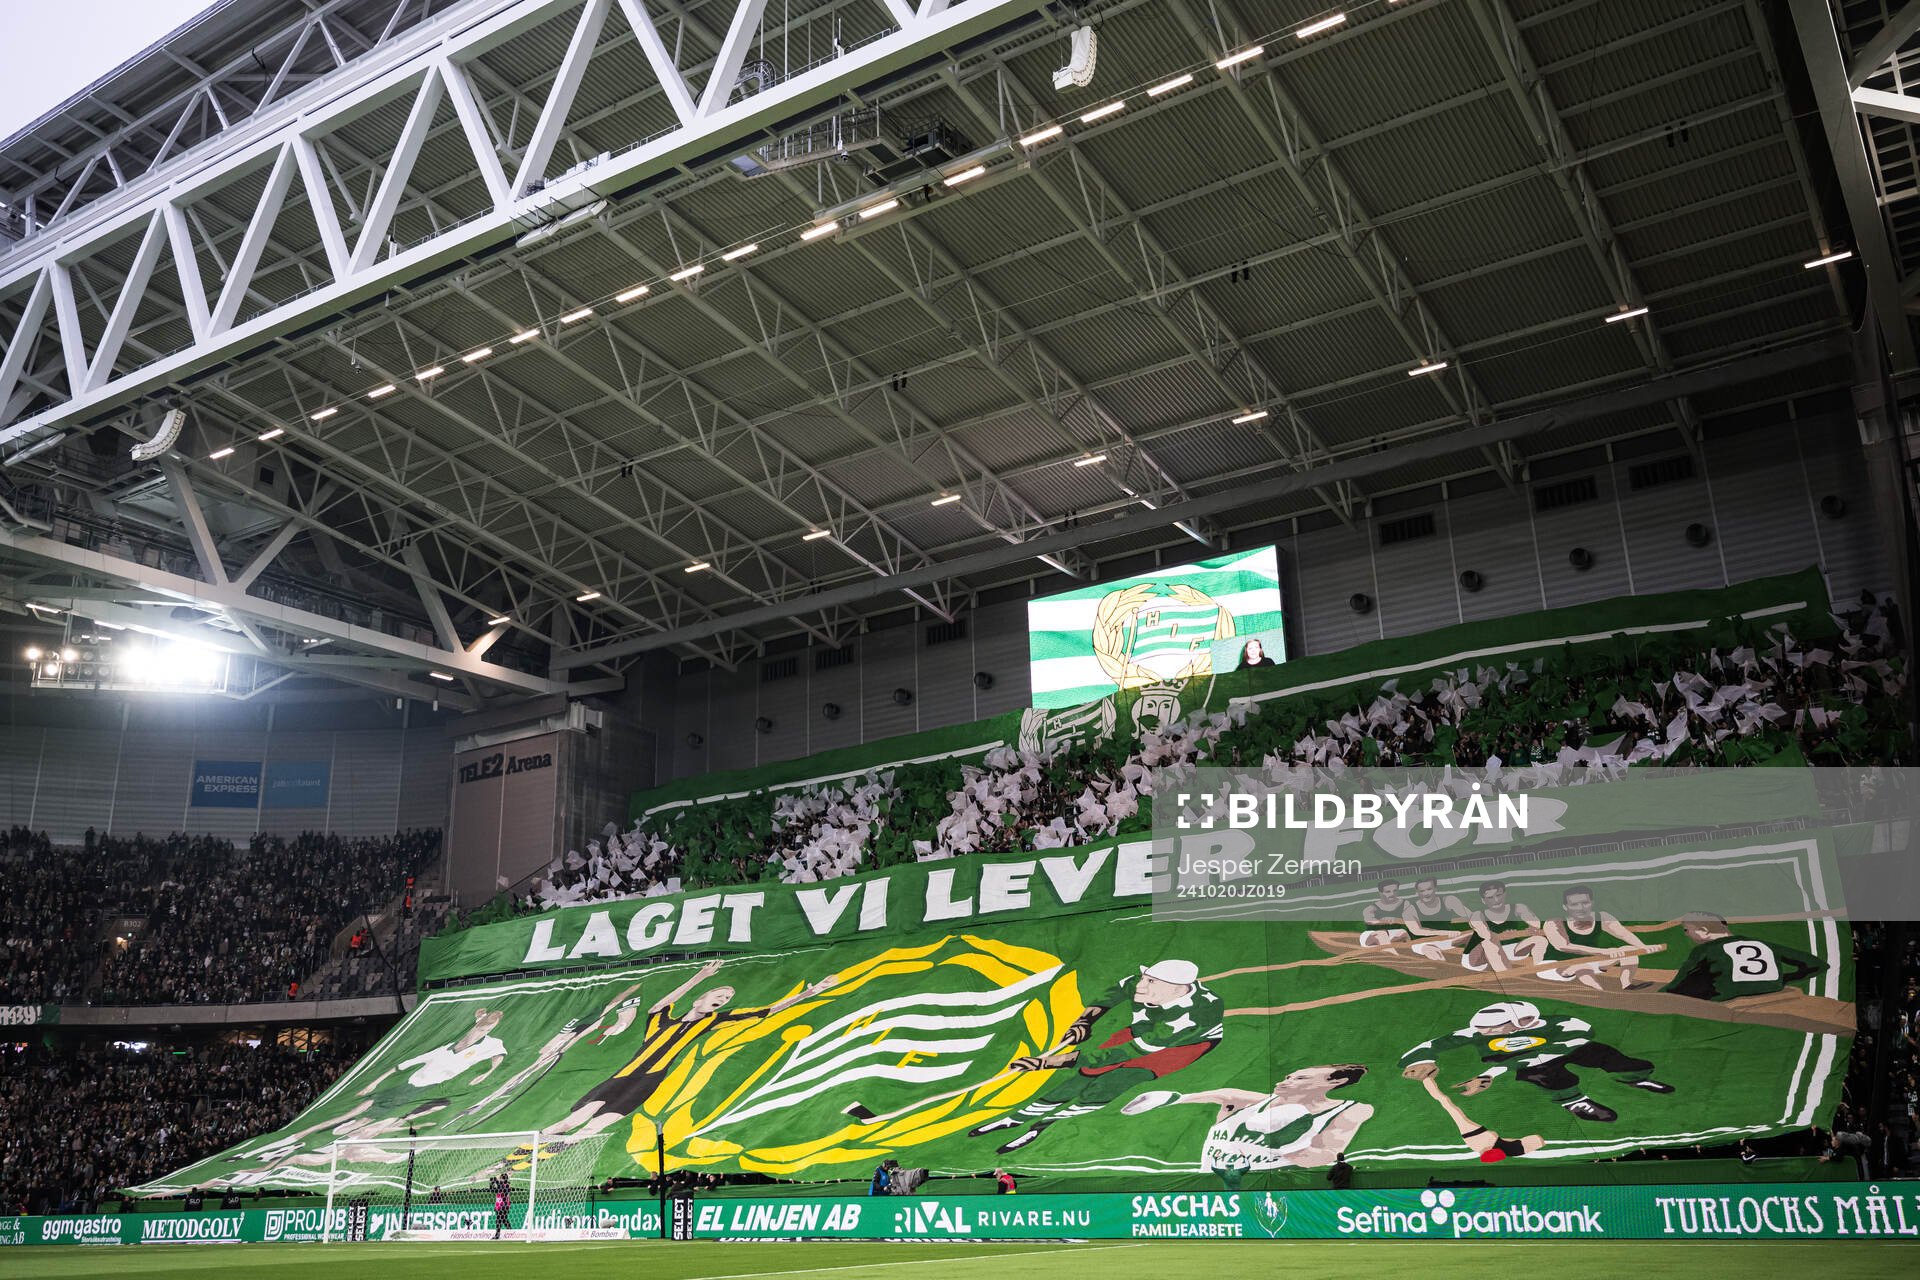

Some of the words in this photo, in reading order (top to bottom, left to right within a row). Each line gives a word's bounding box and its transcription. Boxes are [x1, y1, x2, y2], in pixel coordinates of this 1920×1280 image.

[196, 775, 258, 785] AMERICAN
[460, 752, 504, 784] TELE2
[505, 753, 552, 775] Arena
[204, 784, 257, 793] EXPRESS
[522, 892, 764, 963] LAGET
[795, 877, 890, 934] VI
[923, 829, 1255, 922] LEVER
[1736, 945, 1768, 975] 3
[673, 1198, 684, 1240] SELECT
[696, 1205, 724, 1231] EL
[730, 1204, 821, 1231] LINJEN
[822, 1204, 862, 1231] AB
[895, 1201, 971, 1233] RIVAL
[978, 1210, 1090, 1226] RIVARE.NU
[1132, 1194, 1240, 1218] SASCHAS
[1655, 1195, 1824, 1235] TURLOCKS
[1833, 1185, 1920, 1235] MÅL
[42, 1215, 122, 1240] ggmgastro
[141, 1217, 244, 1239] METODGOLV
[355, 1205, 366, 1241] SELECT
[1132, 1223, 1243, 1237] FAMILJEARBETE
[1337, 1205, 1427, 1233] Sefina
[1453, 1205, 1604, 1238] pantbank
[11, 1231, 25, 1245] AB
